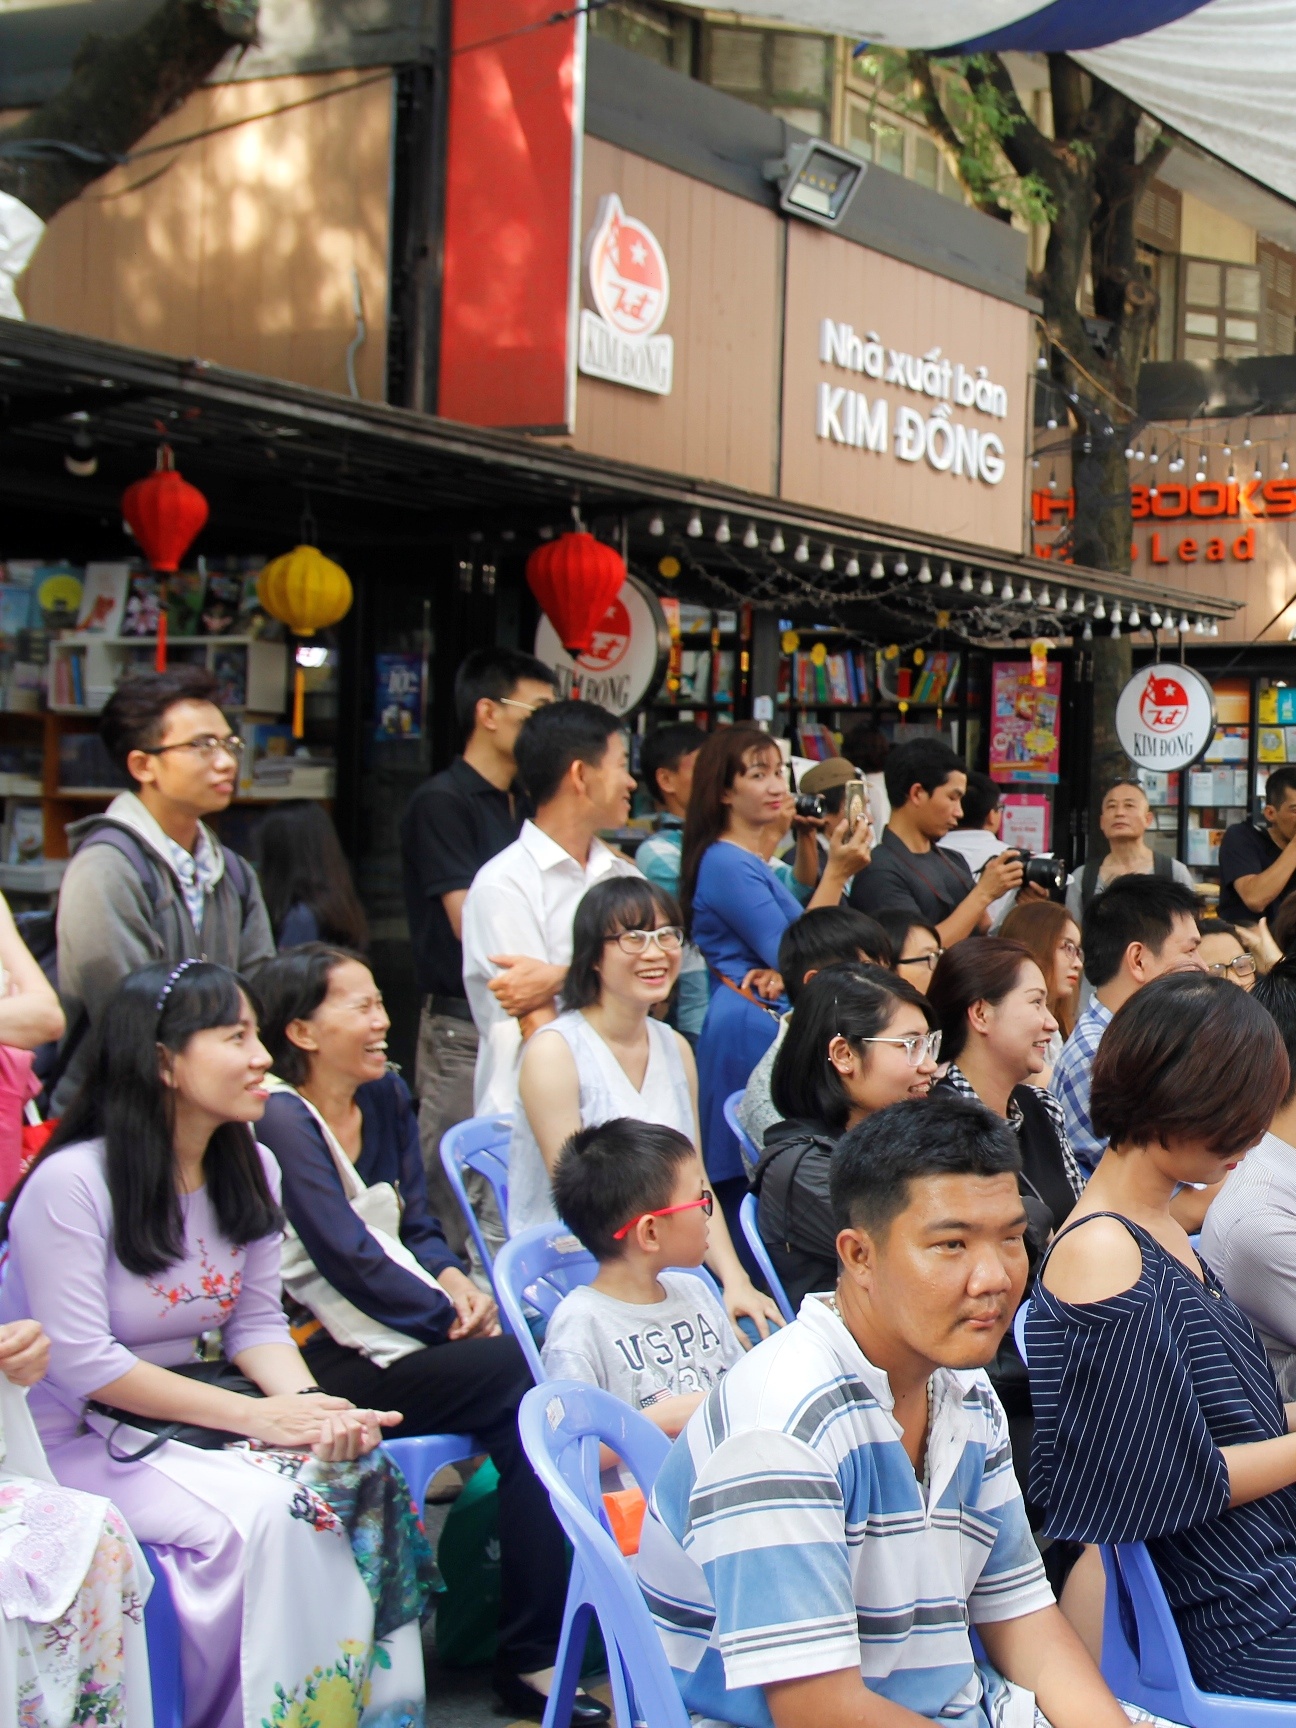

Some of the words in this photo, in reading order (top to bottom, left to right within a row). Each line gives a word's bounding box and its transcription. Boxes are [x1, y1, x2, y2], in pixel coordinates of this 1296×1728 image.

[820, 317, 884, 378] Nhà
[886, 346, 952, 399] xuất
[954, 363, 1007, 418] bản
[816, 382, 888, 453] KIM
[894, 402, 1006, 485] ĐỒNG
[1151, 528, 1257, 564] Lead
[1133, 731, 1158, 757] KIM
